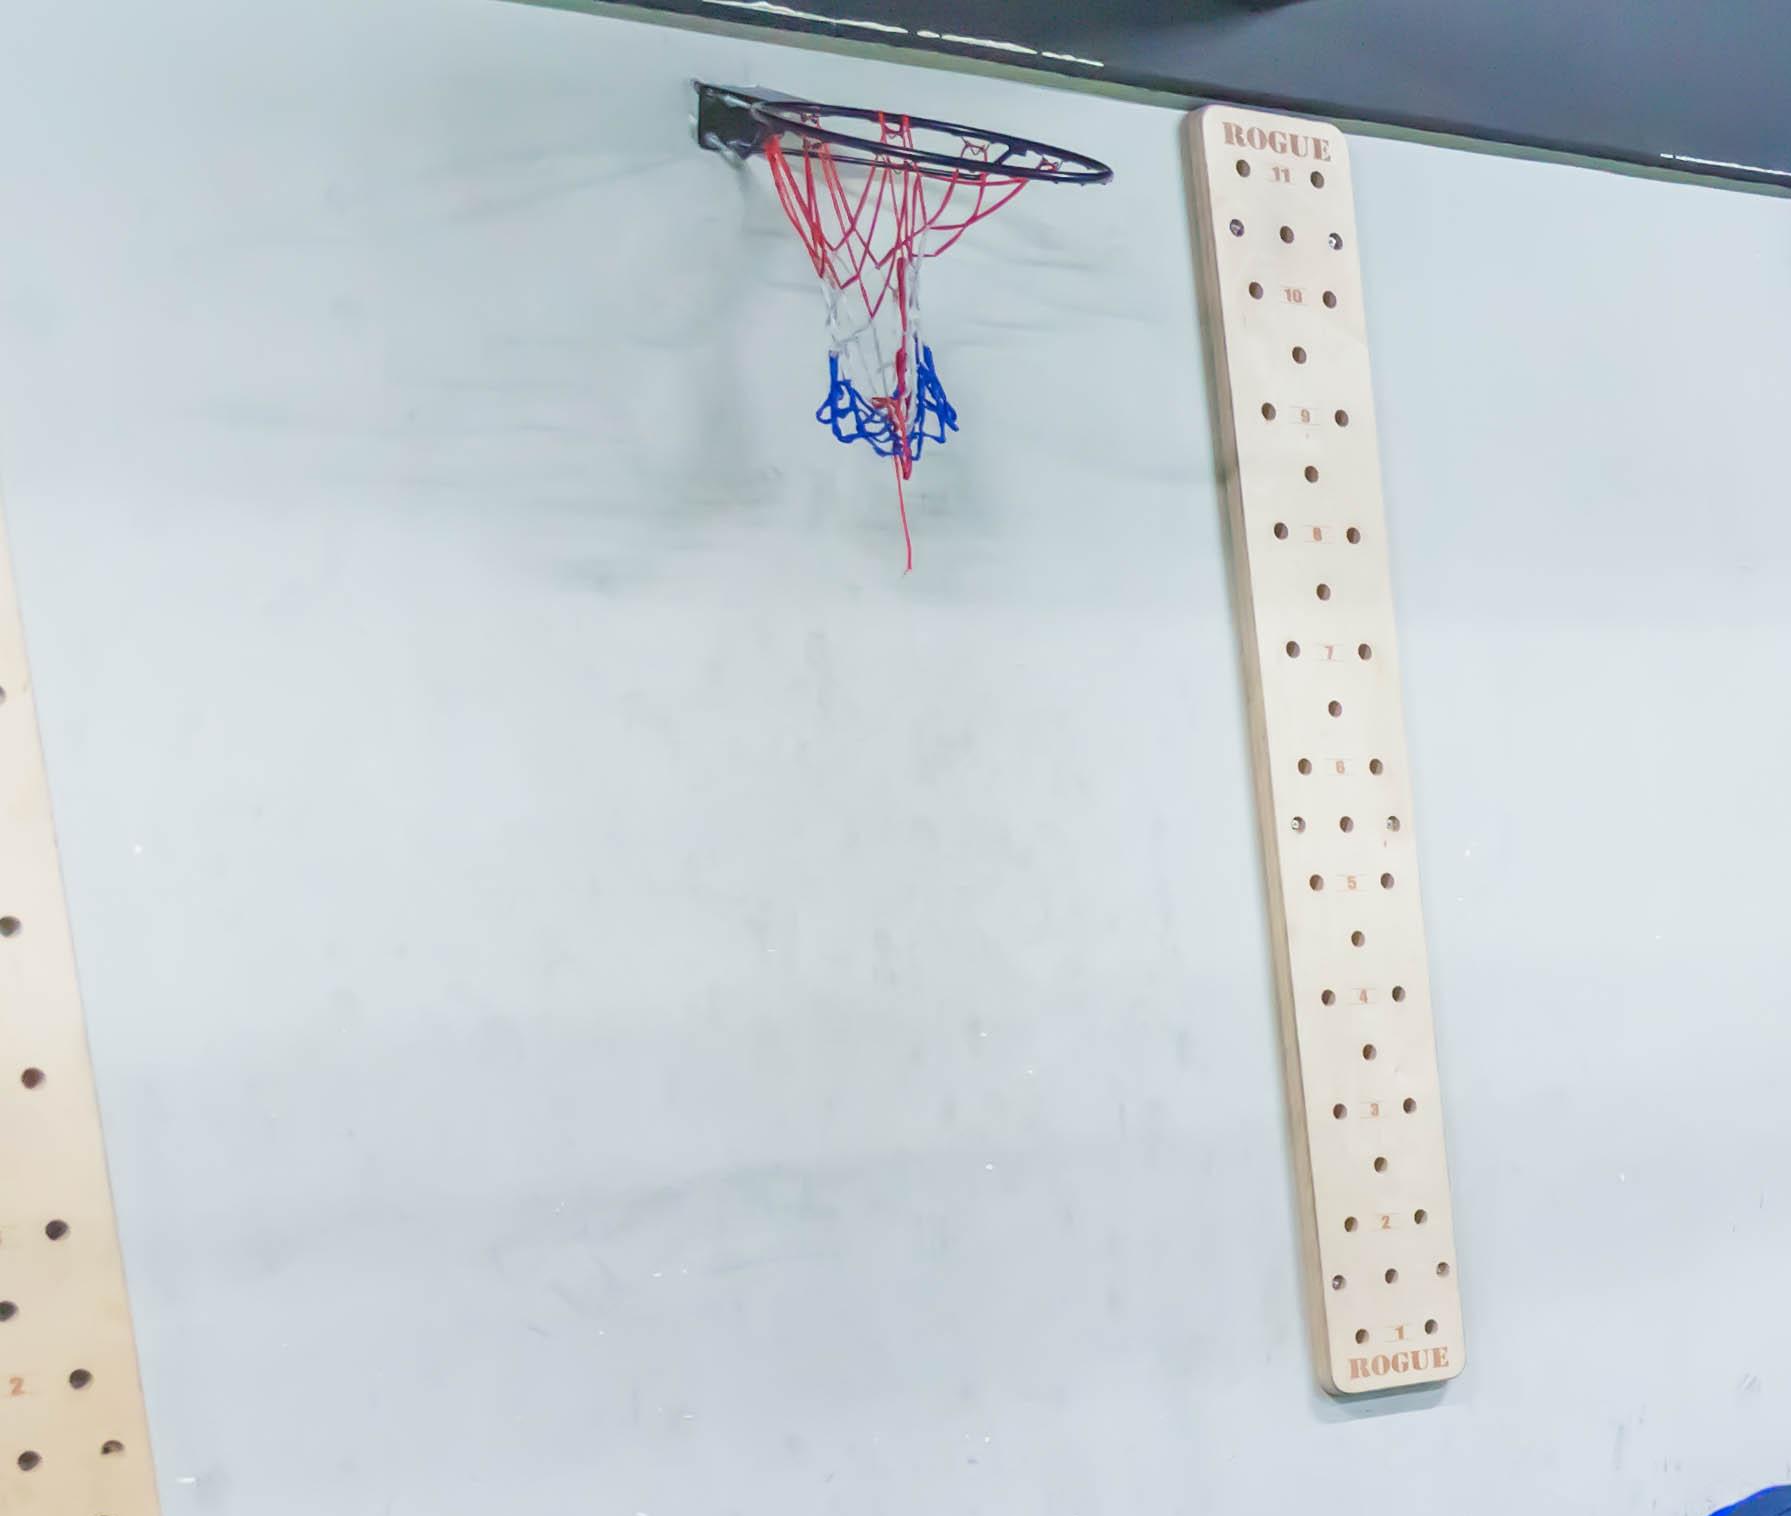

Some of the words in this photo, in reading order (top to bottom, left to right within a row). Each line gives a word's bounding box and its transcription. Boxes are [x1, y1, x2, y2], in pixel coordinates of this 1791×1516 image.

[1222, 121, 1332, 163] ROGUE
[1271, 166, 1291, 183] 11
[1347, 875, 1358, 890] 5
[1381, 1214, 1392, 1229] 2
[1394, 1325, 1405, 1340] 1
[1348, 1346, 1450, 1380] ROGUE
[9, 1375, 25, 1396] 2
